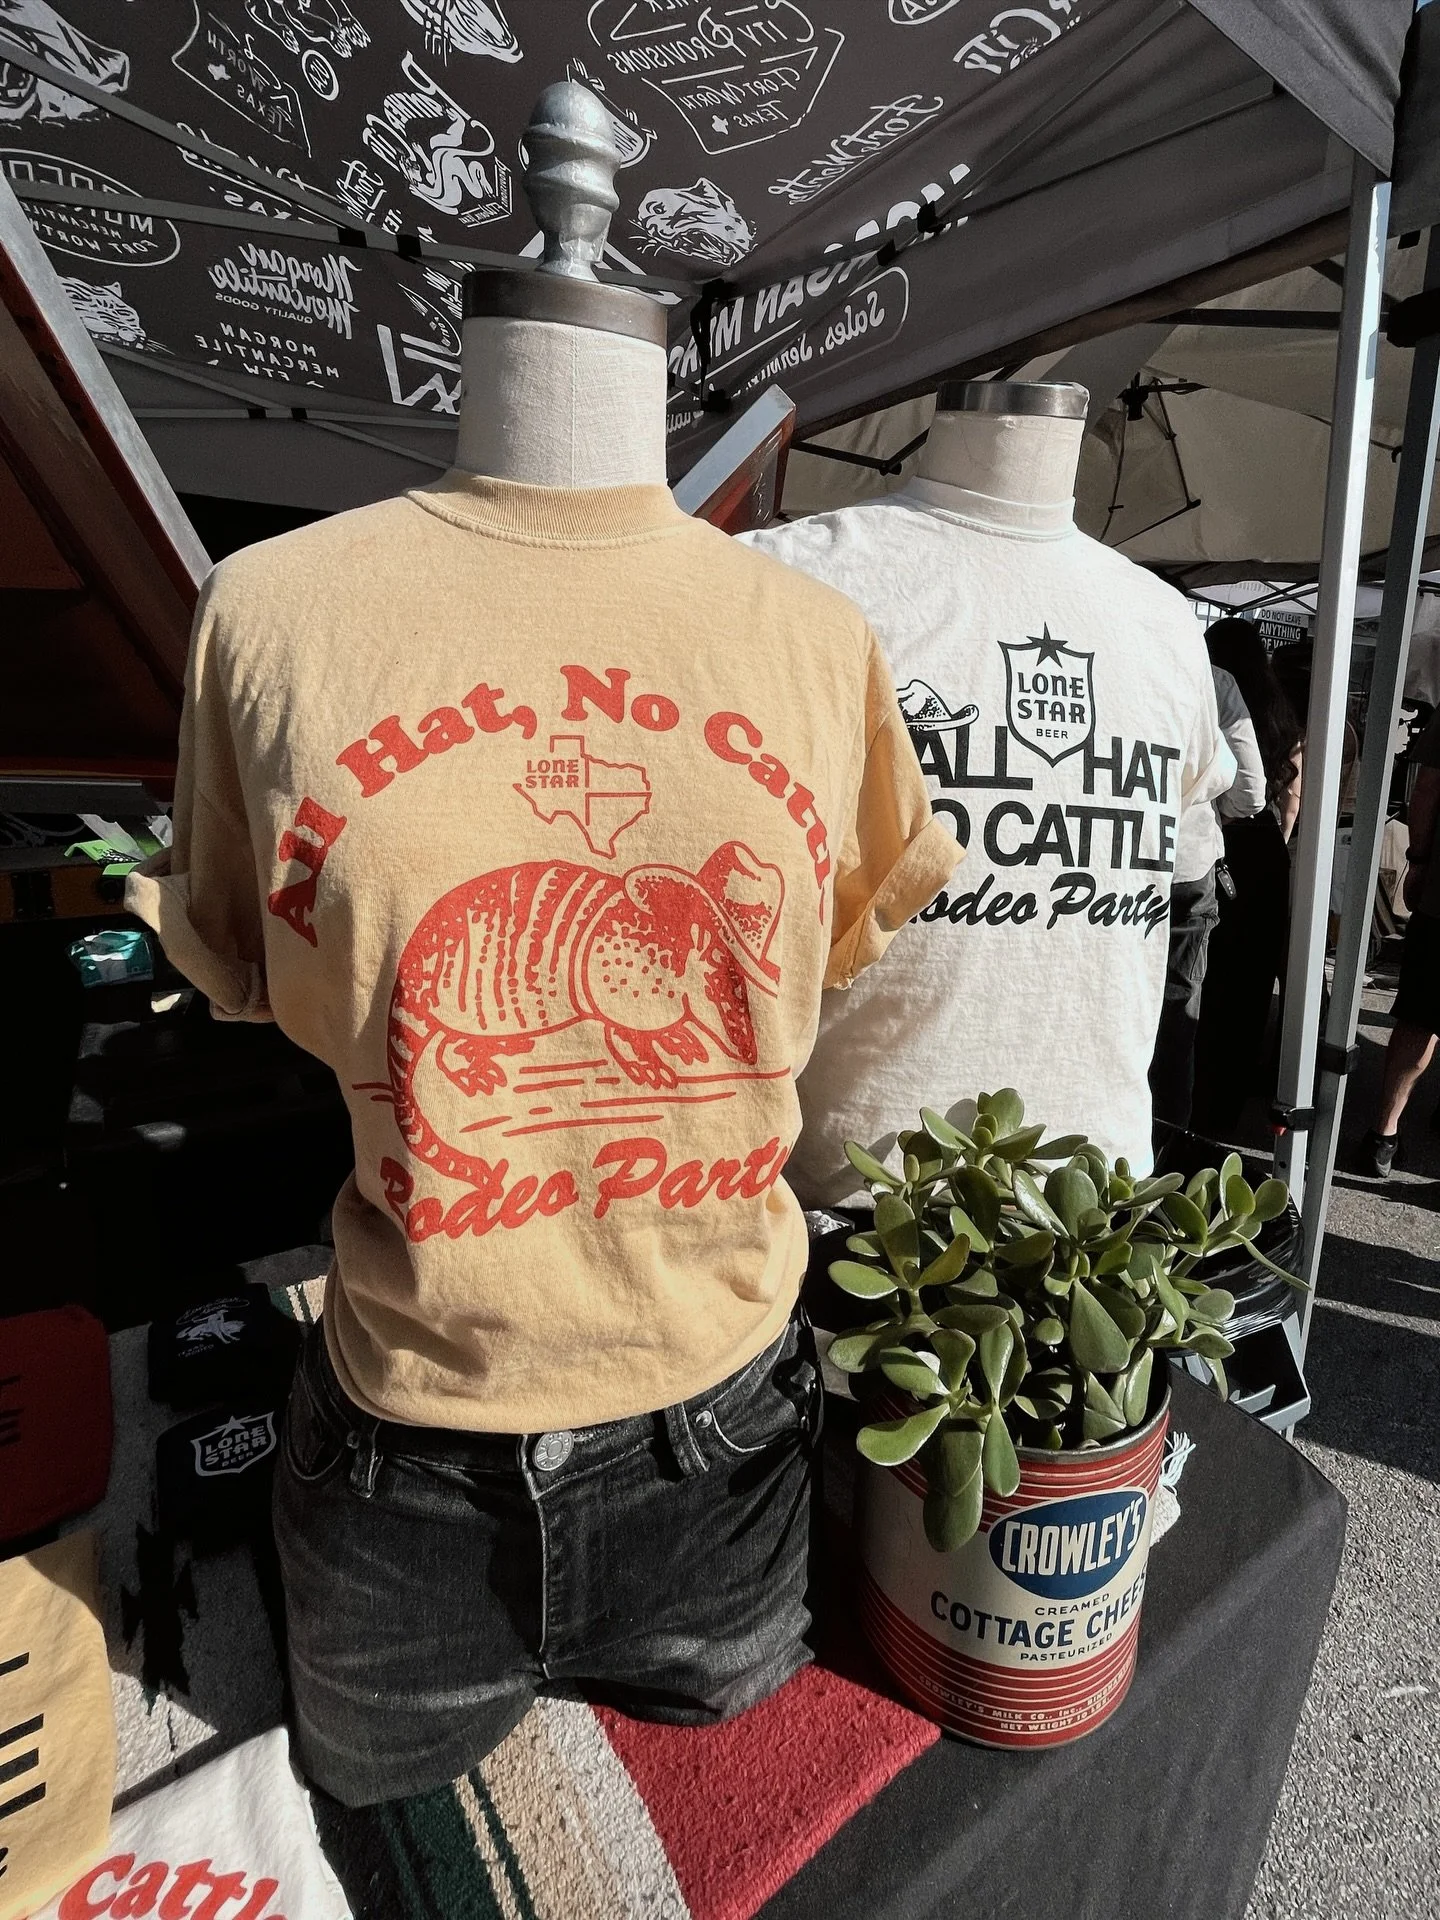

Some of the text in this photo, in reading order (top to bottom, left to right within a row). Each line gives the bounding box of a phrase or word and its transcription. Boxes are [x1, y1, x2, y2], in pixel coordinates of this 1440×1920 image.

[1259, 621, 1301, 640] ANYTHING
[1261, 609, 1302, 625] DO NOT LEAVE
[1017, 671, 1085, 699] LONE
[1017, 699, 1087, 725] STAR
[1036, 728, 1069, 740] BEER
[526, 757, 580, 776] LONE
[909, 724, 1181, 804] ALL HAT
[525, 775, 580, 789] STAR
[268, 796, 347, 947] All
[336, 682, 538, 799] Hat,
[560, 664, 681, 732] No
[983, 800, 1176, 872] CATTLE
[908, 871, 1169, 940] odeo Party
[204, 1435, 267, 1467] STAR
[1001, 1495, 1144, 1576] CROWLEY'S
[1034, 1592, 1110, 1617] CREAMED
[930, 1590, 1075, 1650] COTTAGE
[1019, 1632, 1113, 1662] PASTEURIZED
[918, 1674, 985, 1714] CROWLEY'S
[992, 1710, 1023, 1721] MILK
[1000, 1722, 1024, 1731] NET
[1027, 1718, 1073, 1731] WEIGHT
[58, 1853, 289, 1920] Cattl
